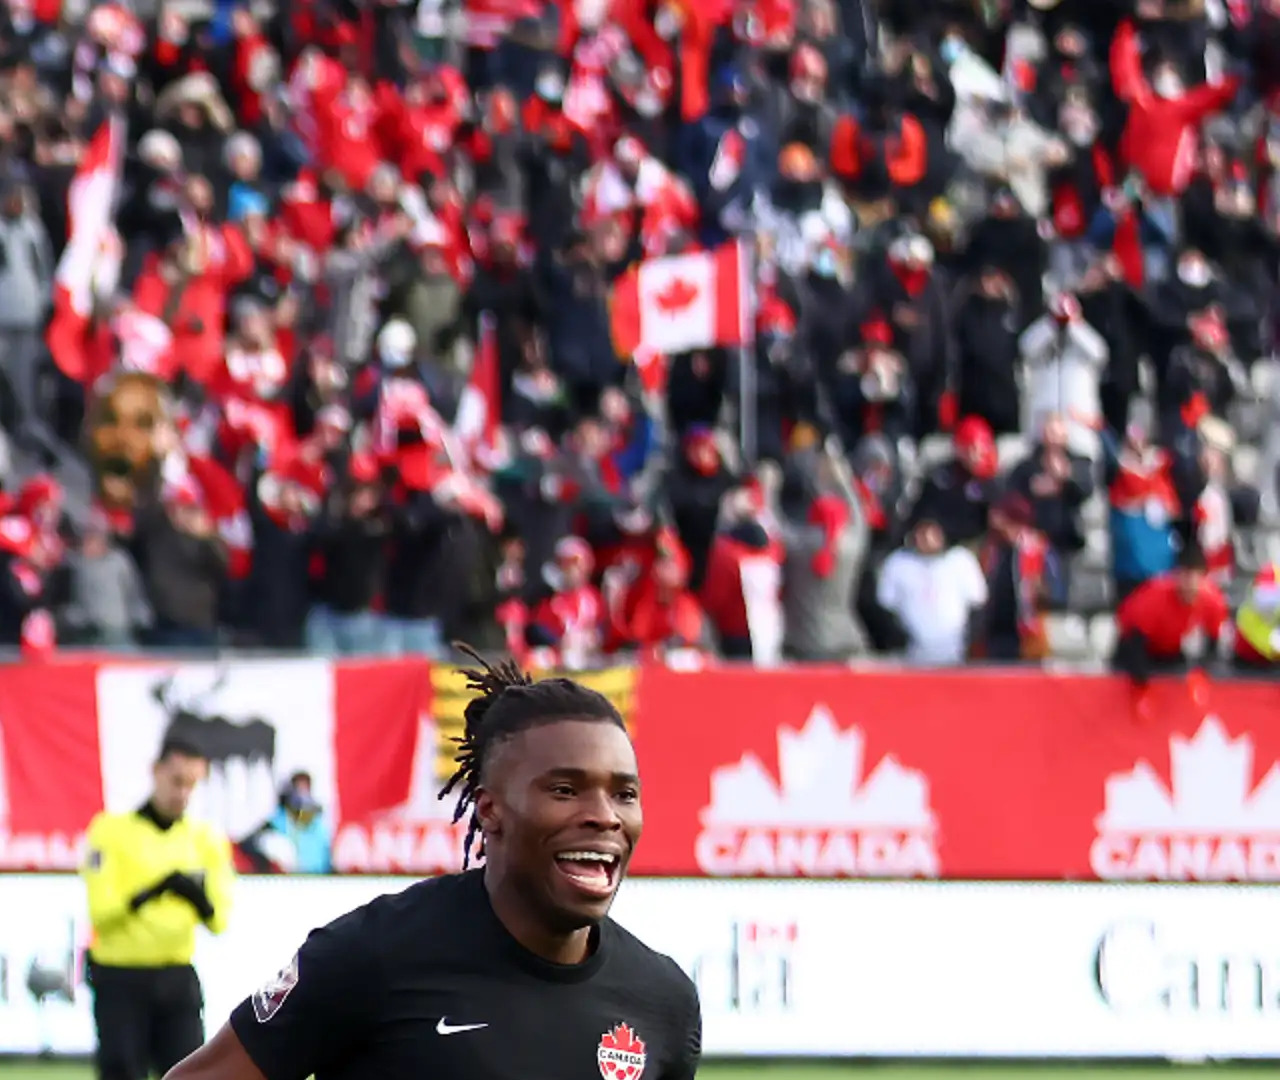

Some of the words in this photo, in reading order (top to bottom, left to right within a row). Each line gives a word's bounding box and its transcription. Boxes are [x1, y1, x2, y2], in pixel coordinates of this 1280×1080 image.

[695, 827, 941, 878] CANADA
[1093, 914, 1280, 1015] Can
[599, 1049, 643, 1065] CANADA
